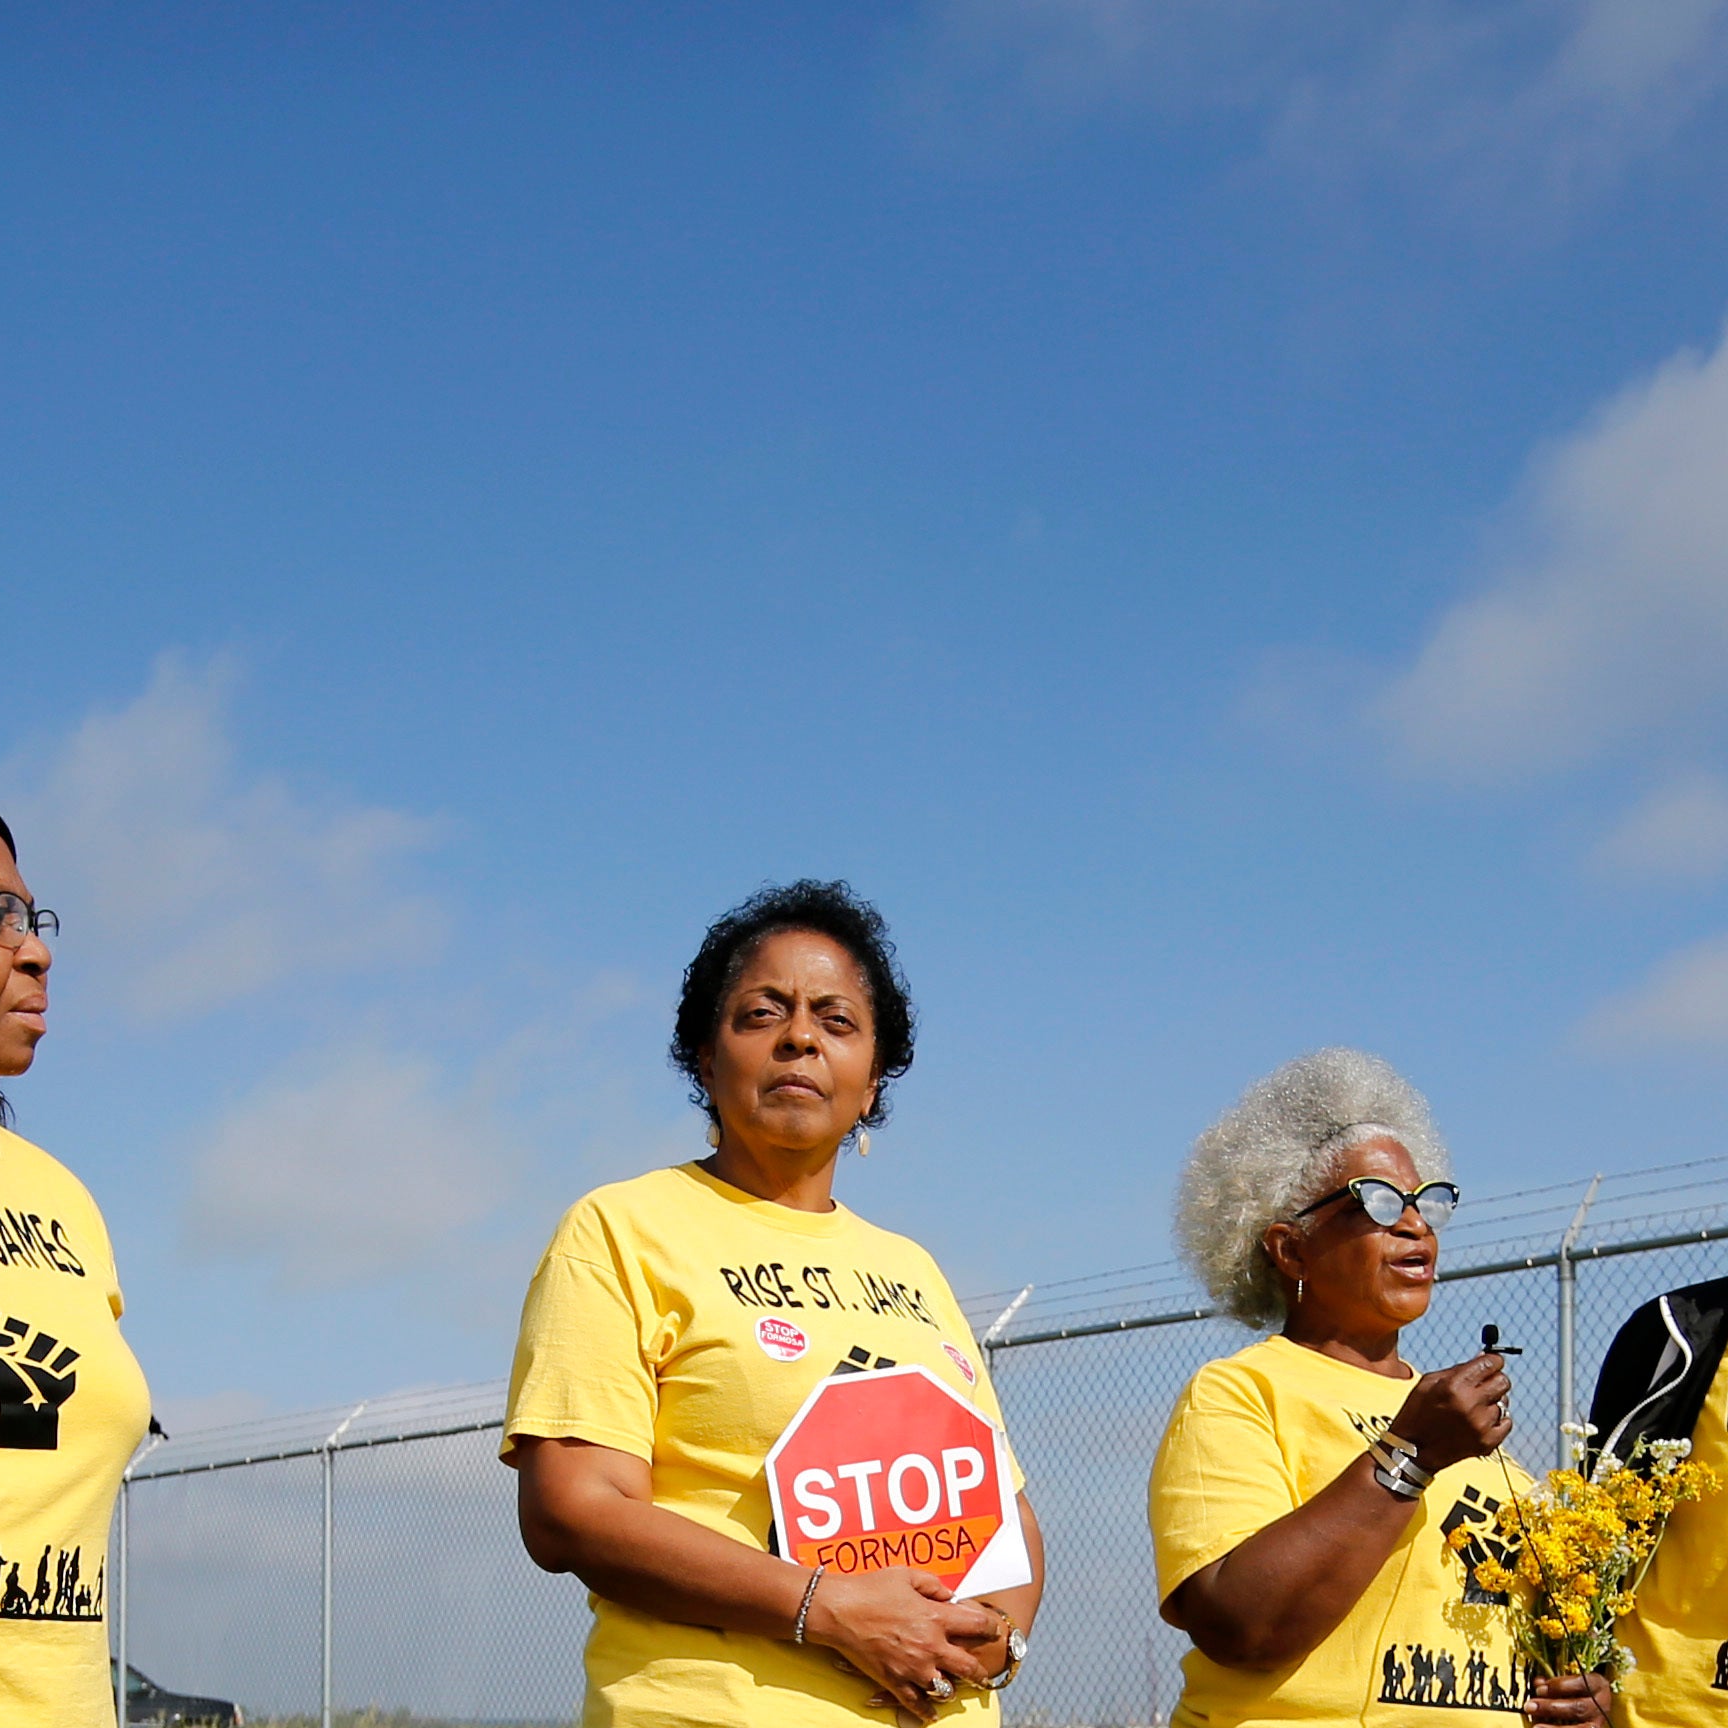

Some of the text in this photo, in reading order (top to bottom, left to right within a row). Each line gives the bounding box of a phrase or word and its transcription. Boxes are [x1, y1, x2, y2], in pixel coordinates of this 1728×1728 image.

[719, 1263, 941, 1332] RISE ST. JAMES
[761, 1331, 804, 1348] FORMOSA
[764, 1322, 799, 1338] STOP
[793, 1446, 986, 1540] STOP
[816, 1525, 977, 1574] FORMOSA
